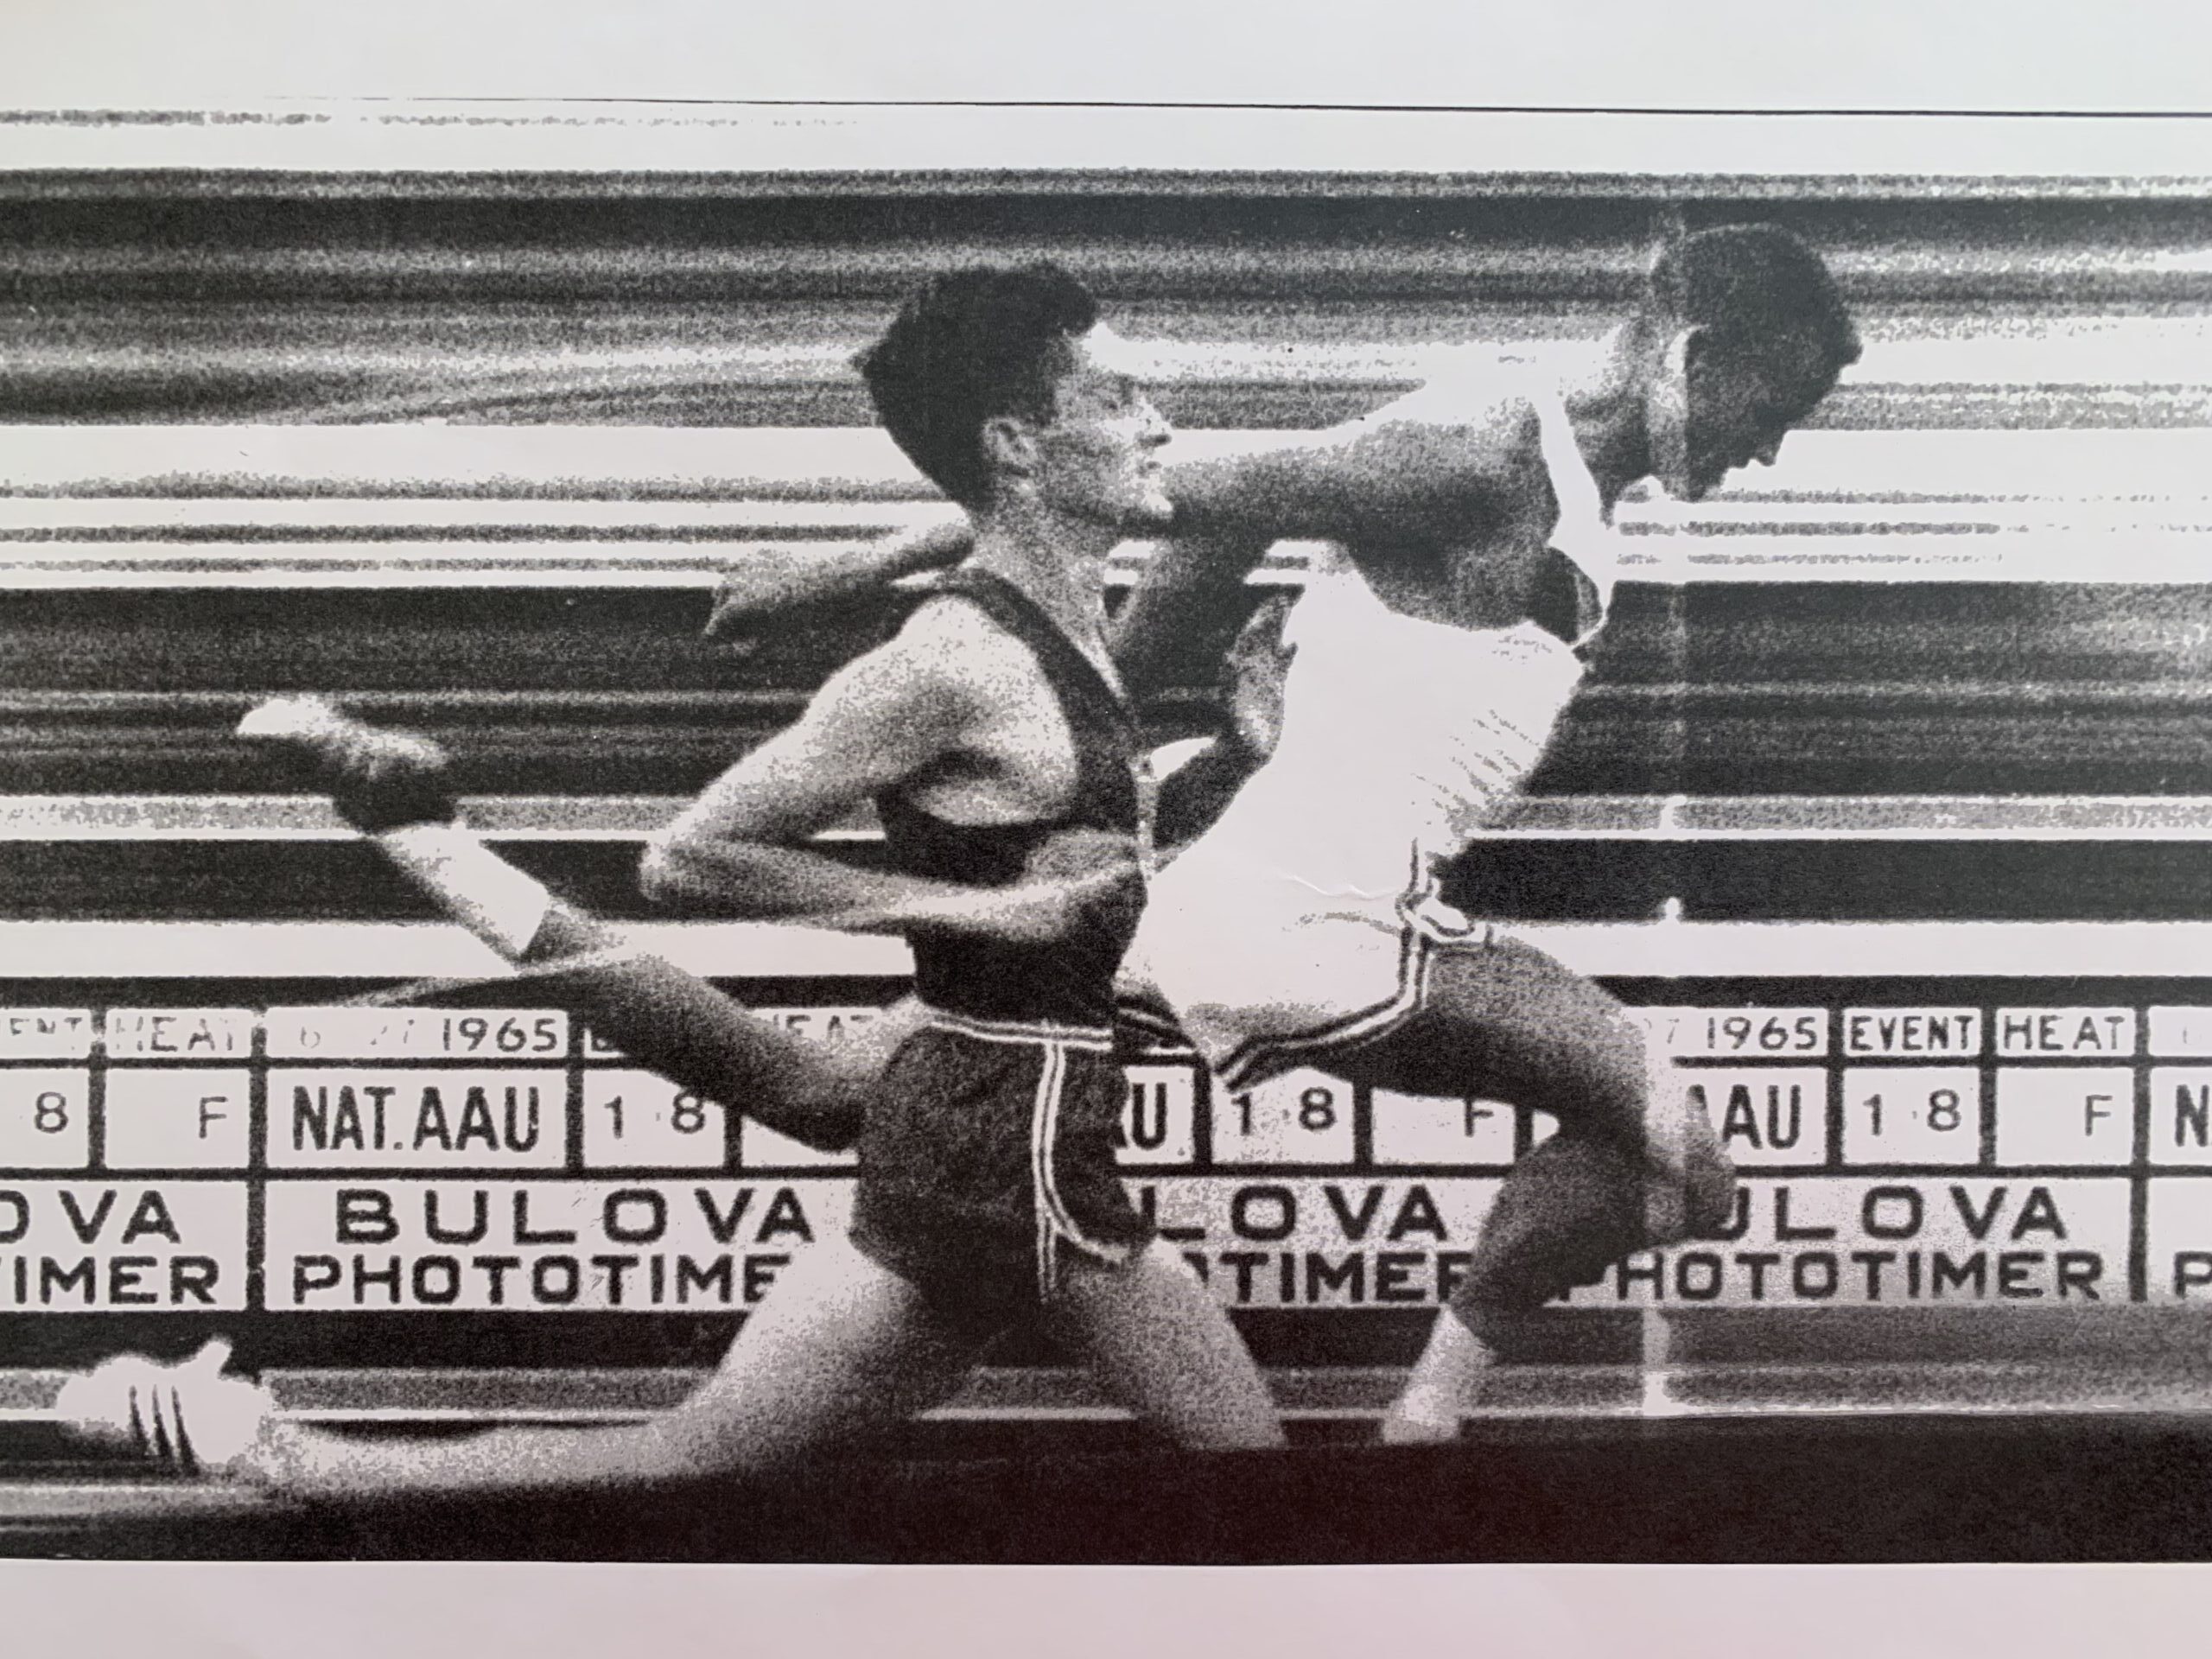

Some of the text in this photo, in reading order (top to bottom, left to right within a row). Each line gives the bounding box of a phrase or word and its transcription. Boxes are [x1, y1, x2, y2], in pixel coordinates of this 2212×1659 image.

[443, 1016, 557, 1052] 1965
[1707, 1015, 1817, 1051] 1965
[1850, 1015, 1974, 1052] EVENT
[2004, 1015, 2126, 1051] HEAT
[34, 1091, 69, 1134] 8
[199, 1096, 228, 1139] F
[2084, 1095, 2113, 1136] F
[336, 1187, 816, 1245] BULOVA
[0, 1255, 219, 1306] IMER
[1560, 1250, 2103, 1301] HOTOTIMER
